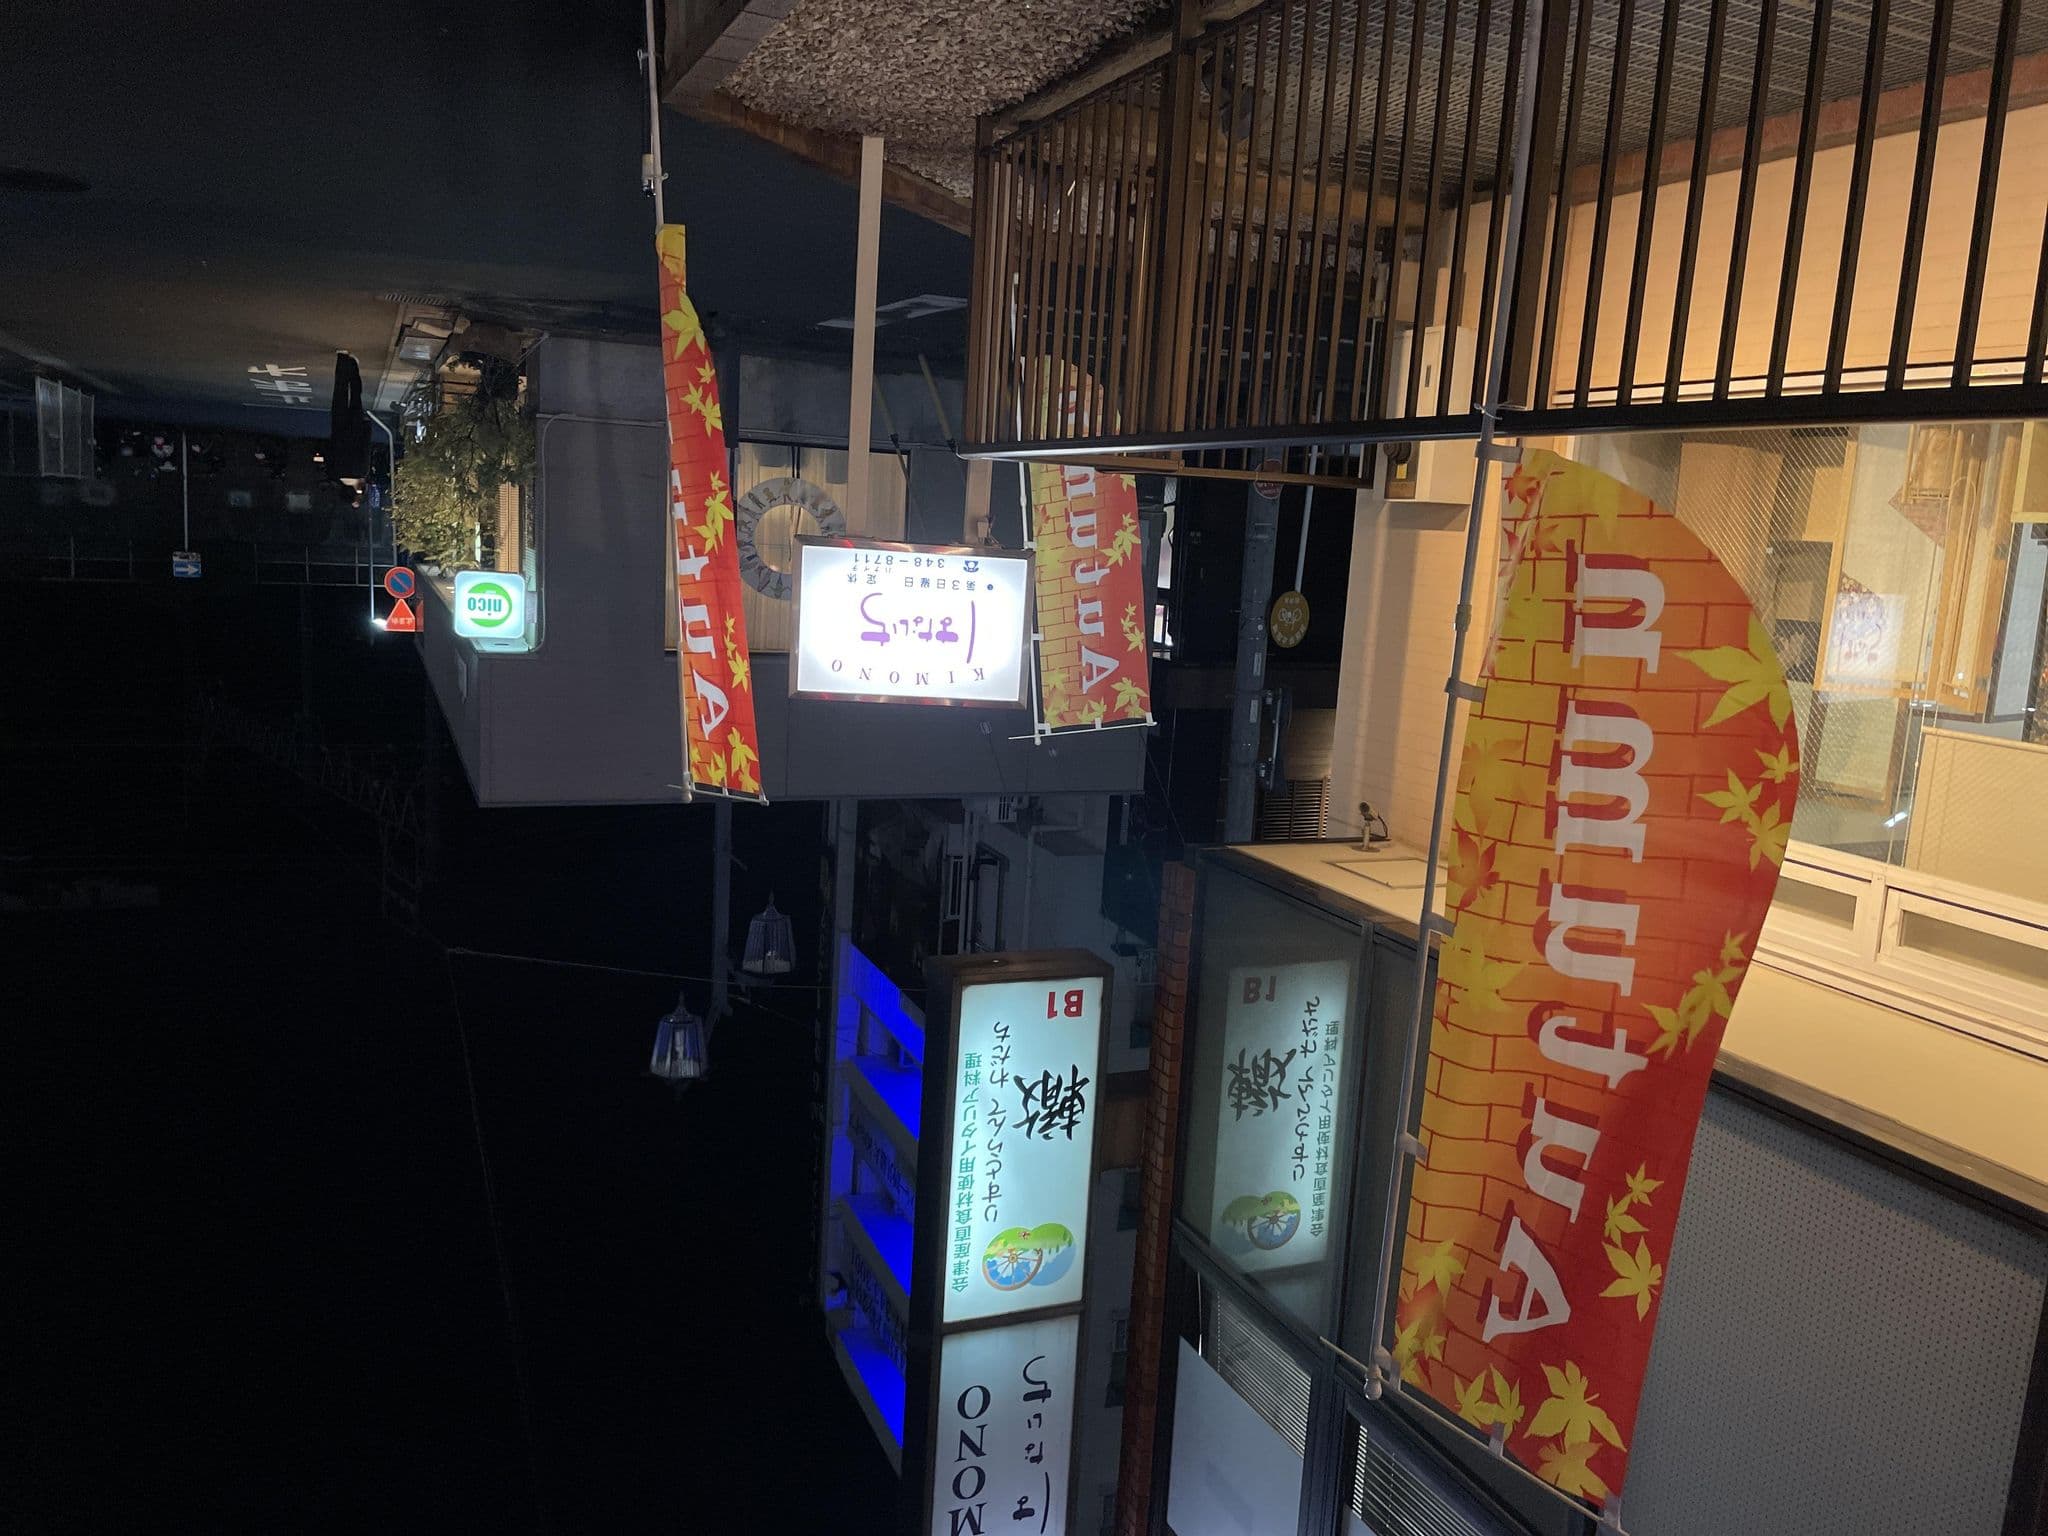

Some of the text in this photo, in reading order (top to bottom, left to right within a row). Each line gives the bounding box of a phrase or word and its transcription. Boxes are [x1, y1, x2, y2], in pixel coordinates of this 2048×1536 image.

[847, 573, 877, 585] 定休
[853, 552, 945, 568] 348-8711
[1063, 465, 1119, 694] Autum
[467, 597, 502, 616] nico
[860, 592, 976, 664] はないち
[831, 659, 985, 686] KIMONO
[1480, 553, 1668, 1343] Autumn
[1046, 989, 1084, 1019] B1
[981, 1021, 1011, 1223] りすとらんて わだち
[1012, 1064, 1091, 1141] 轍
[950, 1051, 982, 1293] 会津産直食材使用イタリア料理
[1013, 1355, 1052, 1534] はないち
